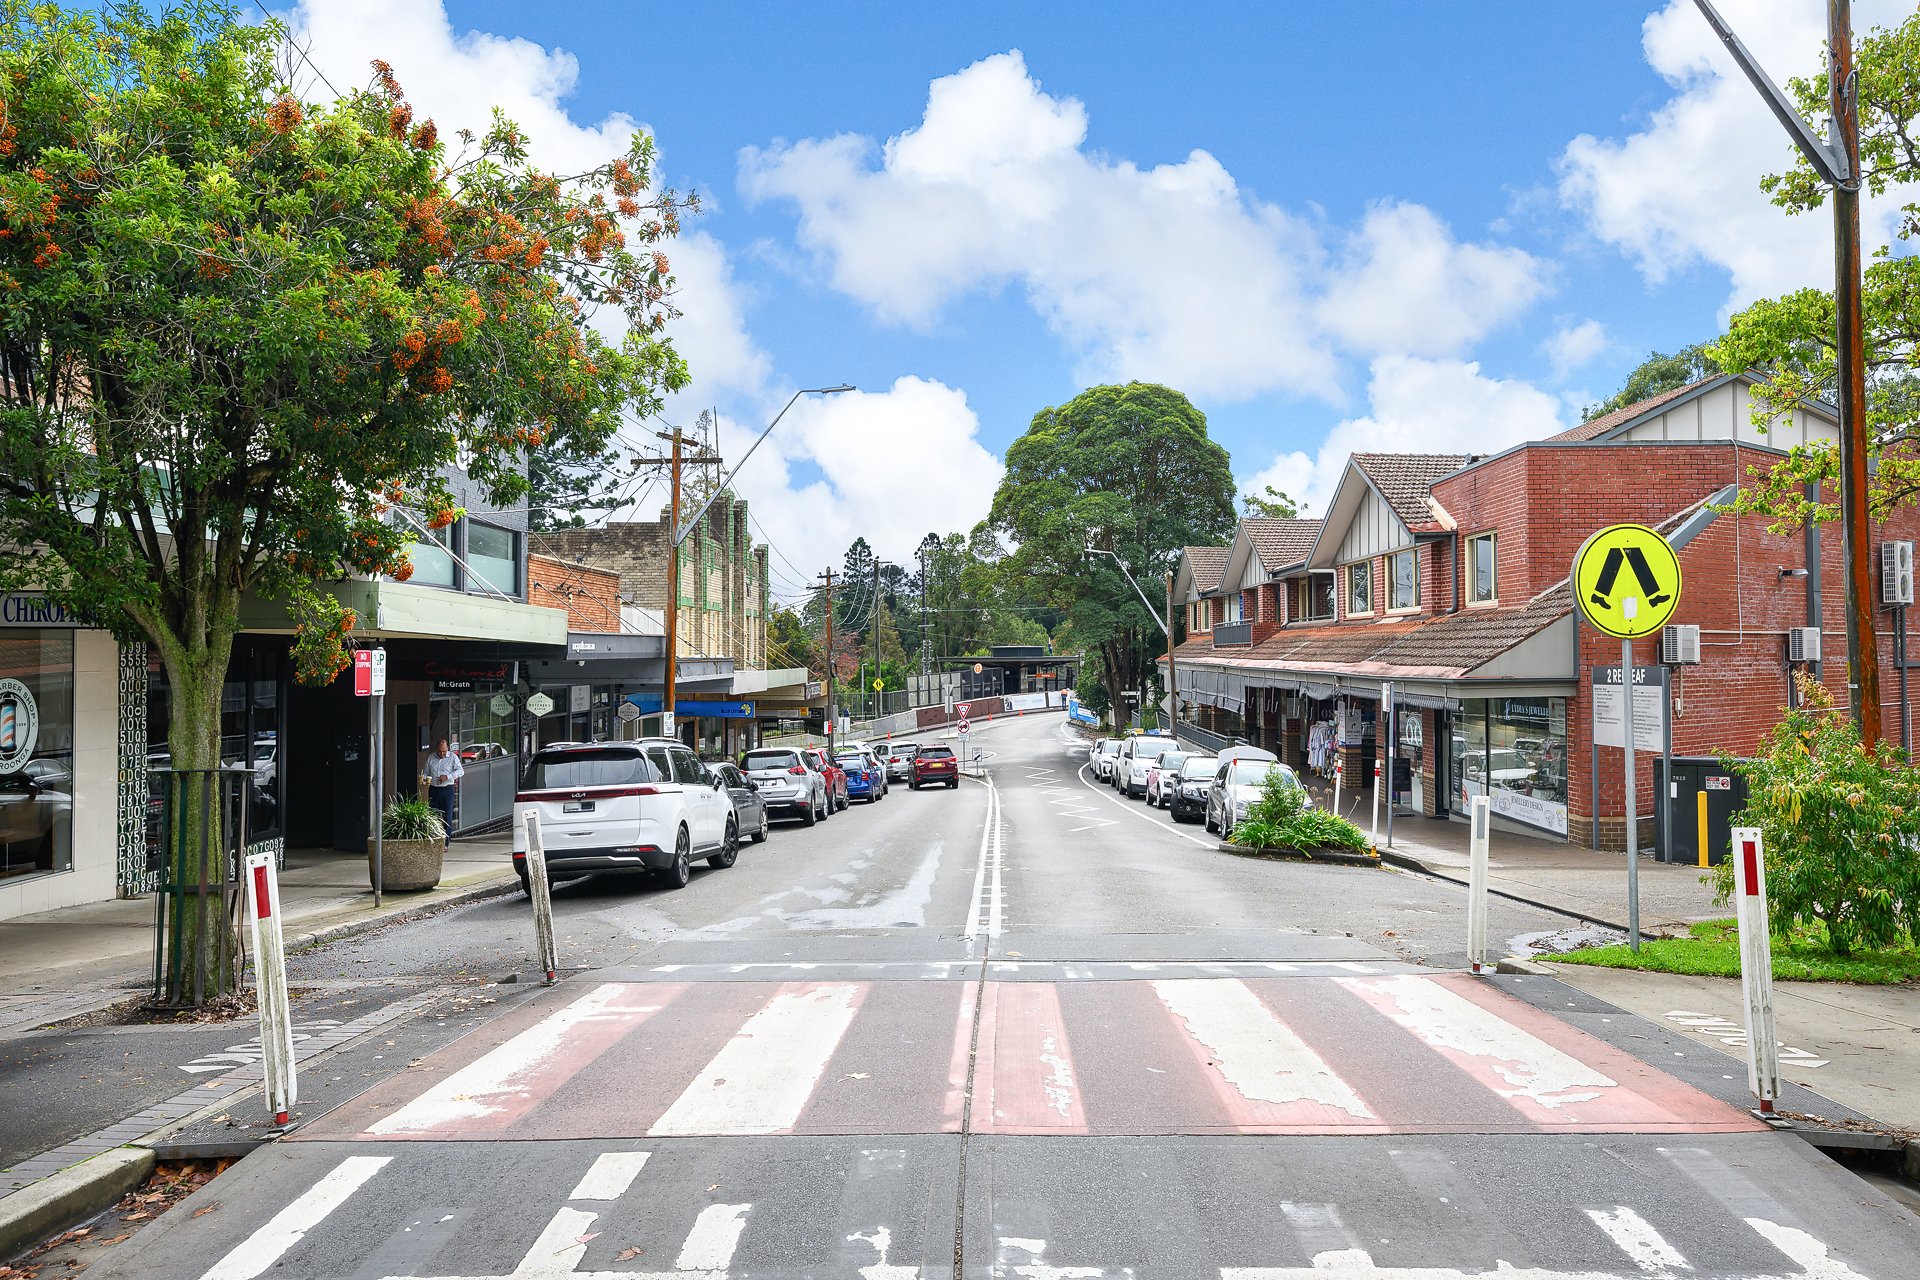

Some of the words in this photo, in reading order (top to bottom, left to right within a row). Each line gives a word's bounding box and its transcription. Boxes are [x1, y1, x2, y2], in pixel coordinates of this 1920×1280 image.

[1607, 668, 1612, 683] 2
[1612, 668, 1646, 684] REEAF
[0, 682, 23, 694] RBER
